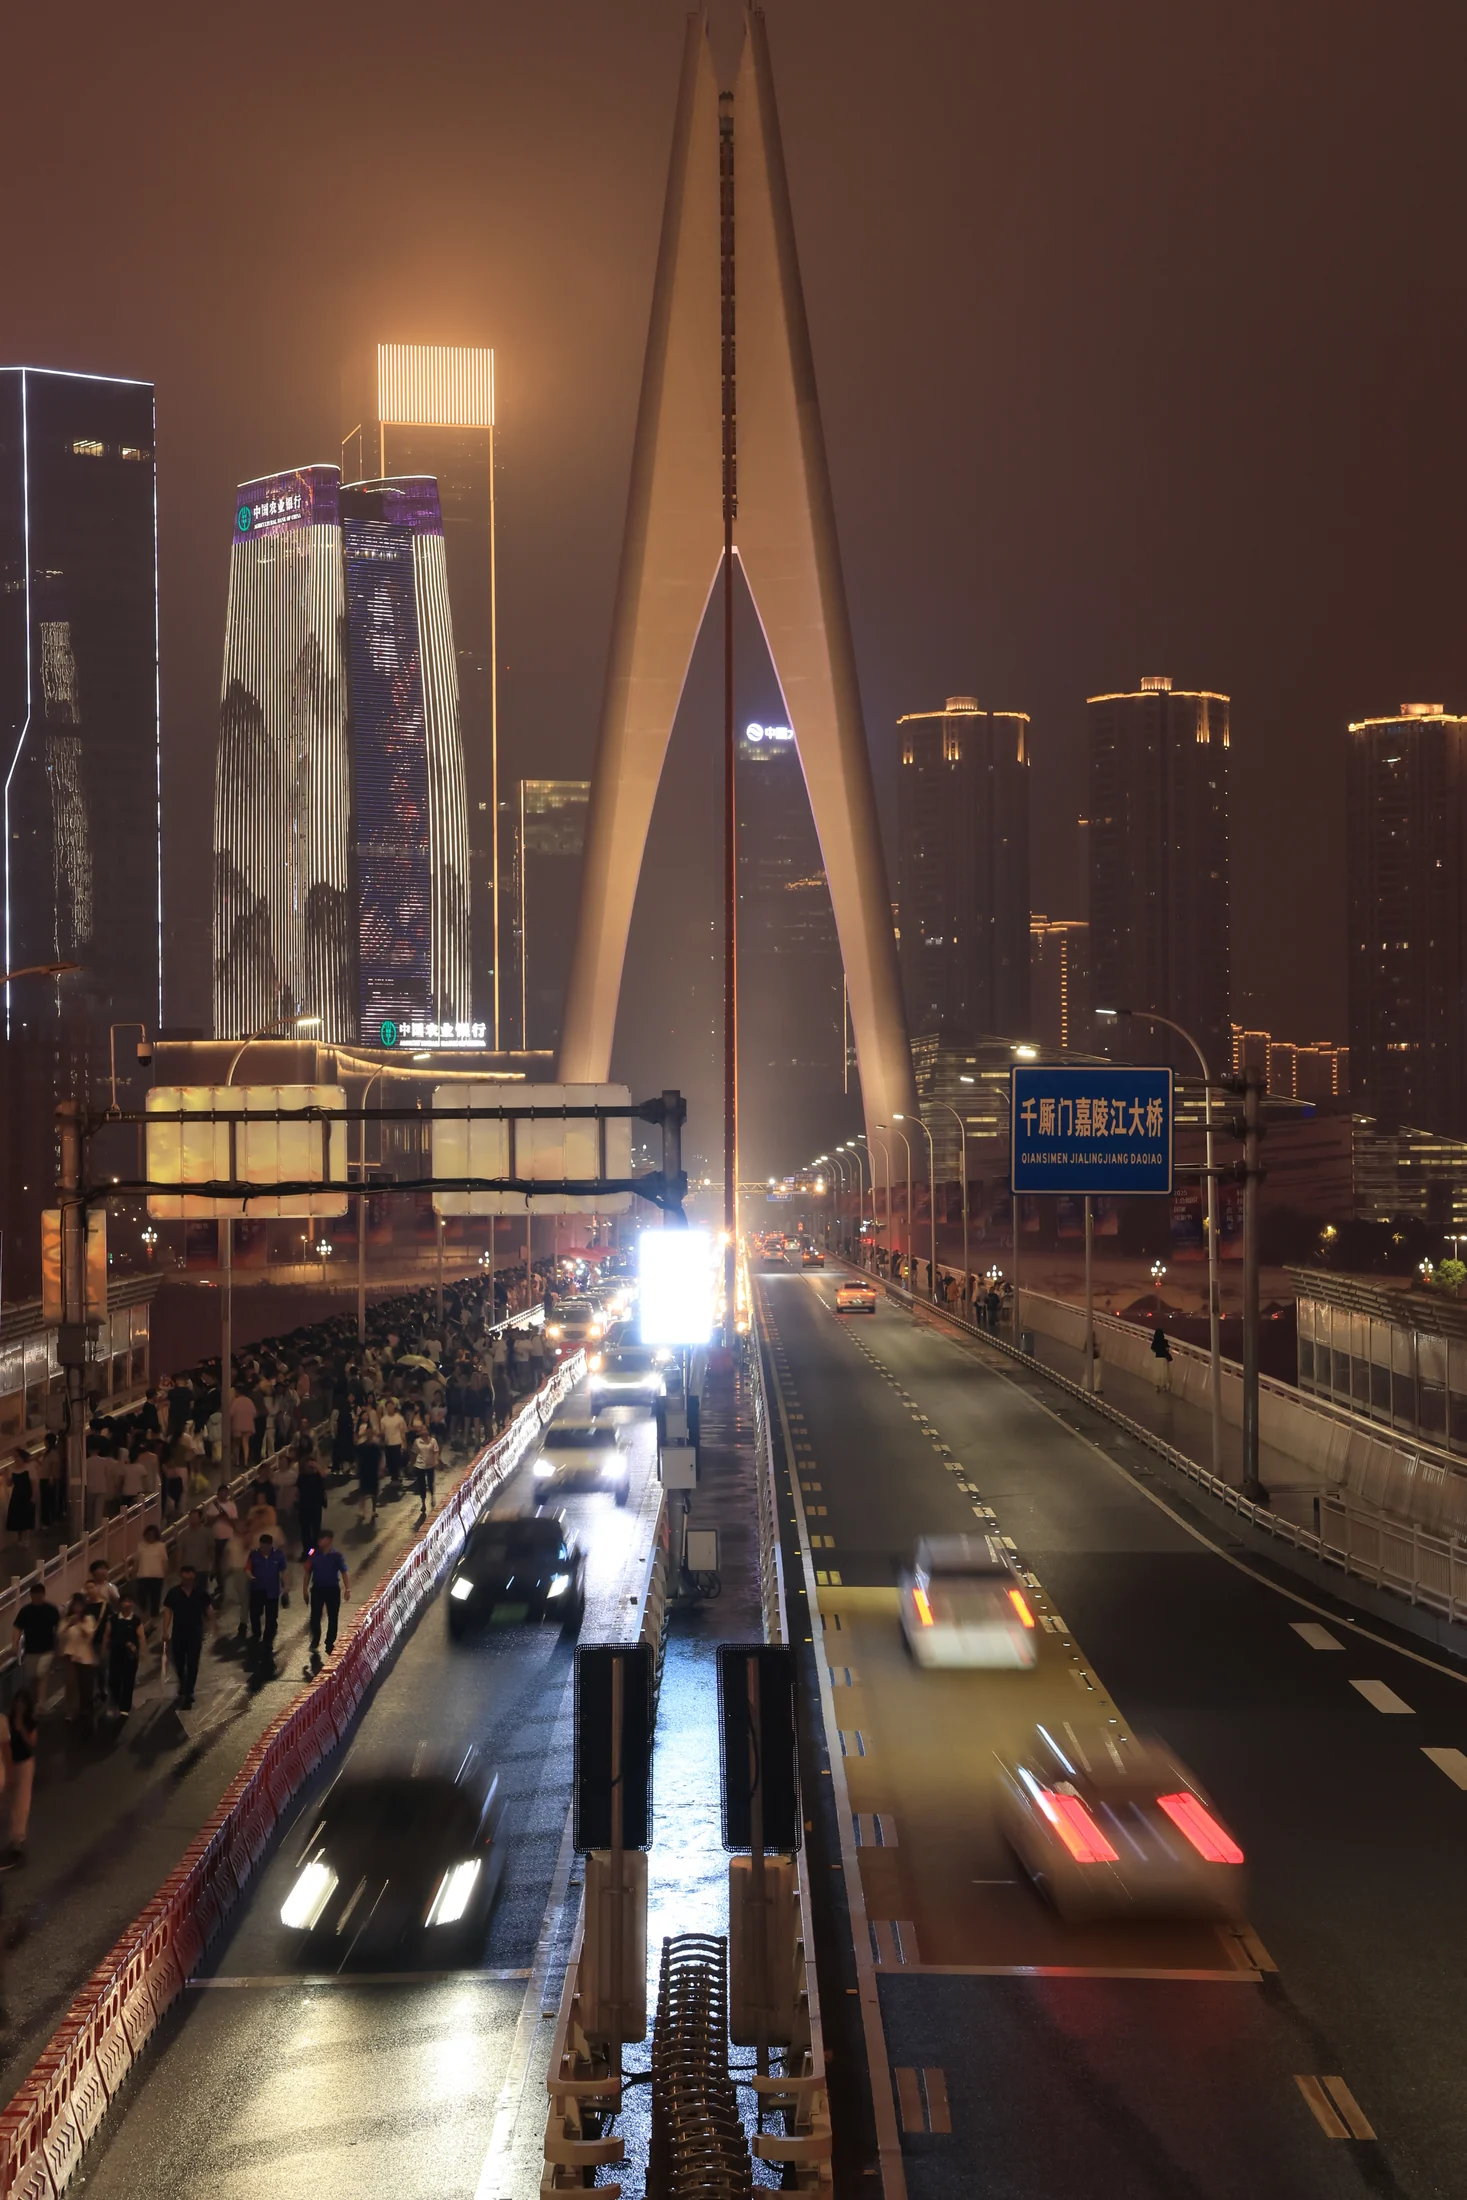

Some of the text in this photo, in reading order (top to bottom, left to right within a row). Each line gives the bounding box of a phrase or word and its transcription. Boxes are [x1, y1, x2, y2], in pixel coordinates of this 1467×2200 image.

[253, 494, 302, 520] 中国农业银行
[399, 1022, 487, 1038] 中国农业银行
[1020, 1097, 1164, 1138] 千厮门嘉陵江大桥
[1021, 1153, 1162, 1165] QIANSIMEN JIALINGJIANG DAQIAO
